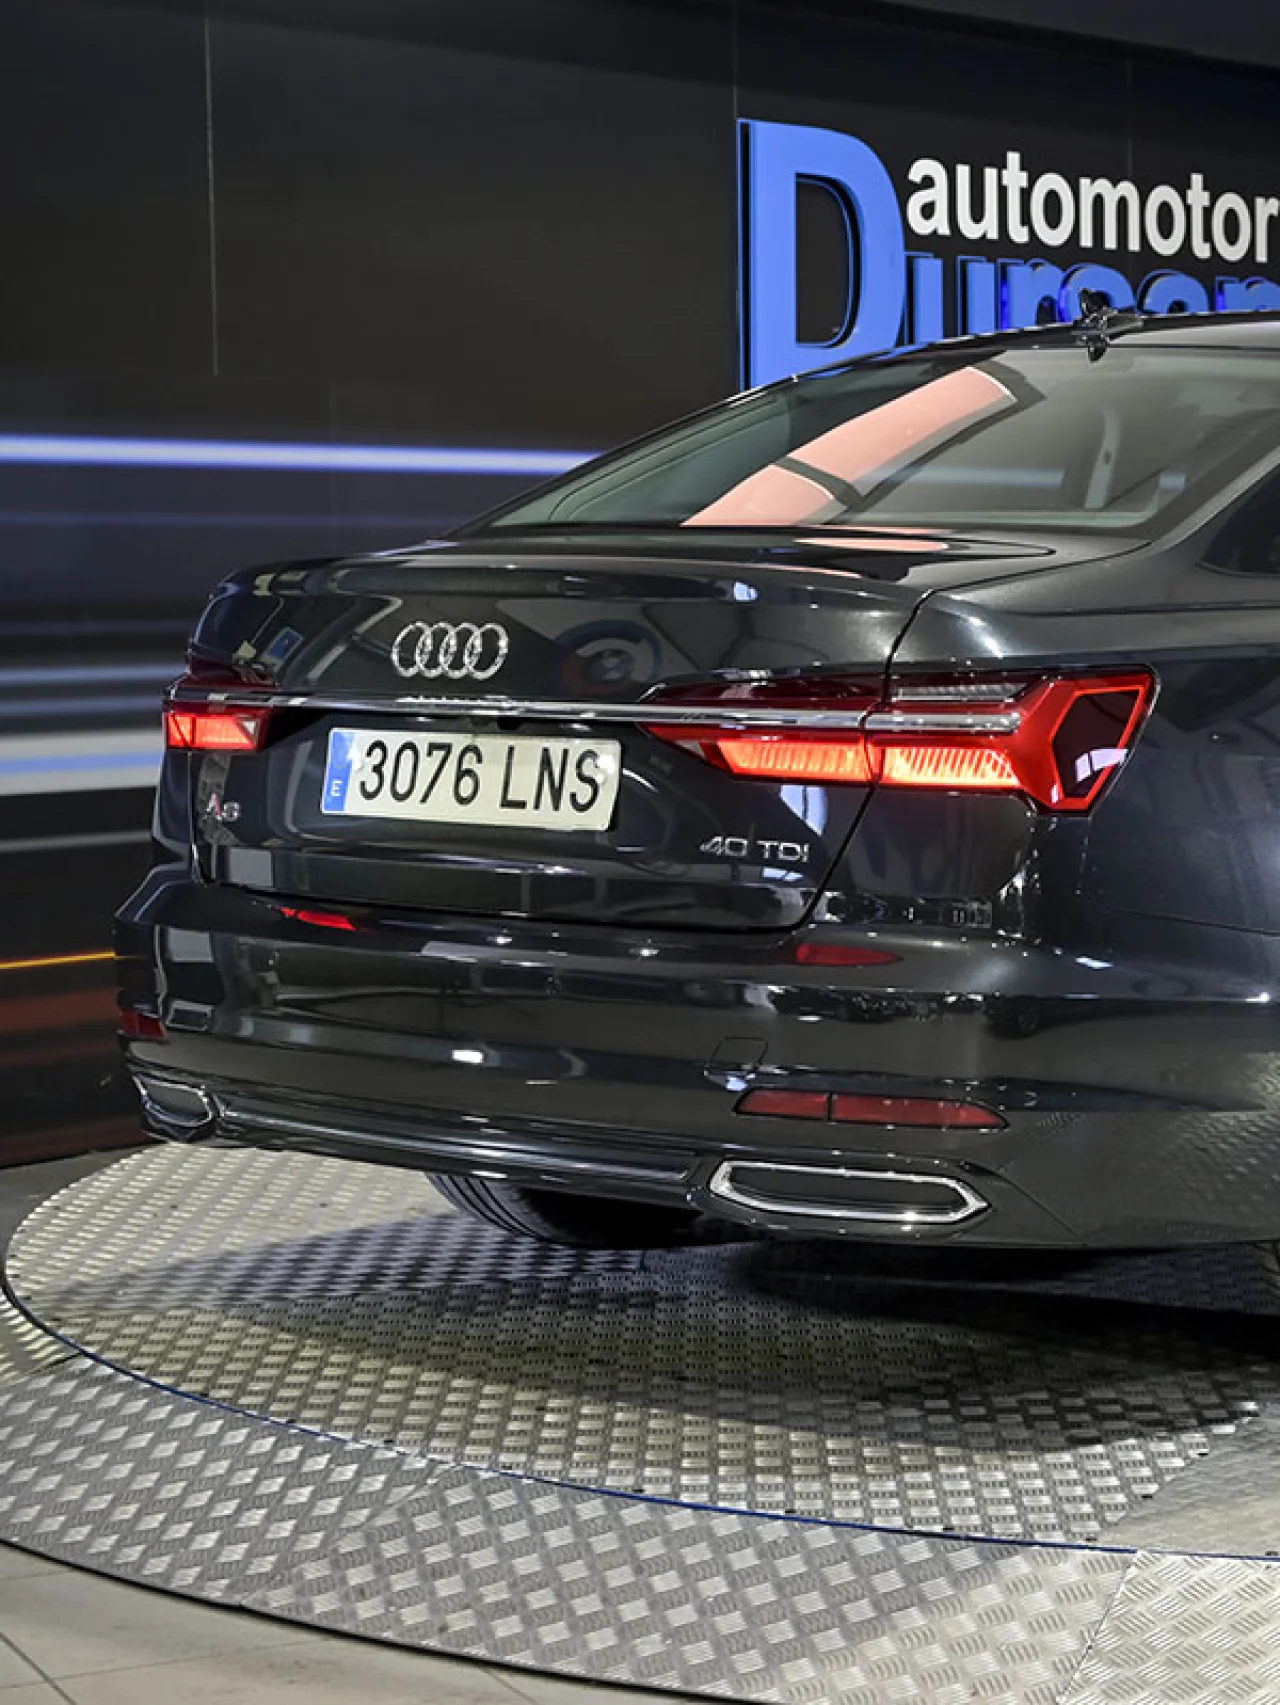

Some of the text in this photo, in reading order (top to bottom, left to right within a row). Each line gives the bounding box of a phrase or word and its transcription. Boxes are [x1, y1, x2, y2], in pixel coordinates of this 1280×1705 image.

[906, 151, 1280, 264] automotor
[330, 780, 342, 797] E
[360, 740, 600, 813] 3076 LNS
[700, 836, 809, 862] 40 TDI
